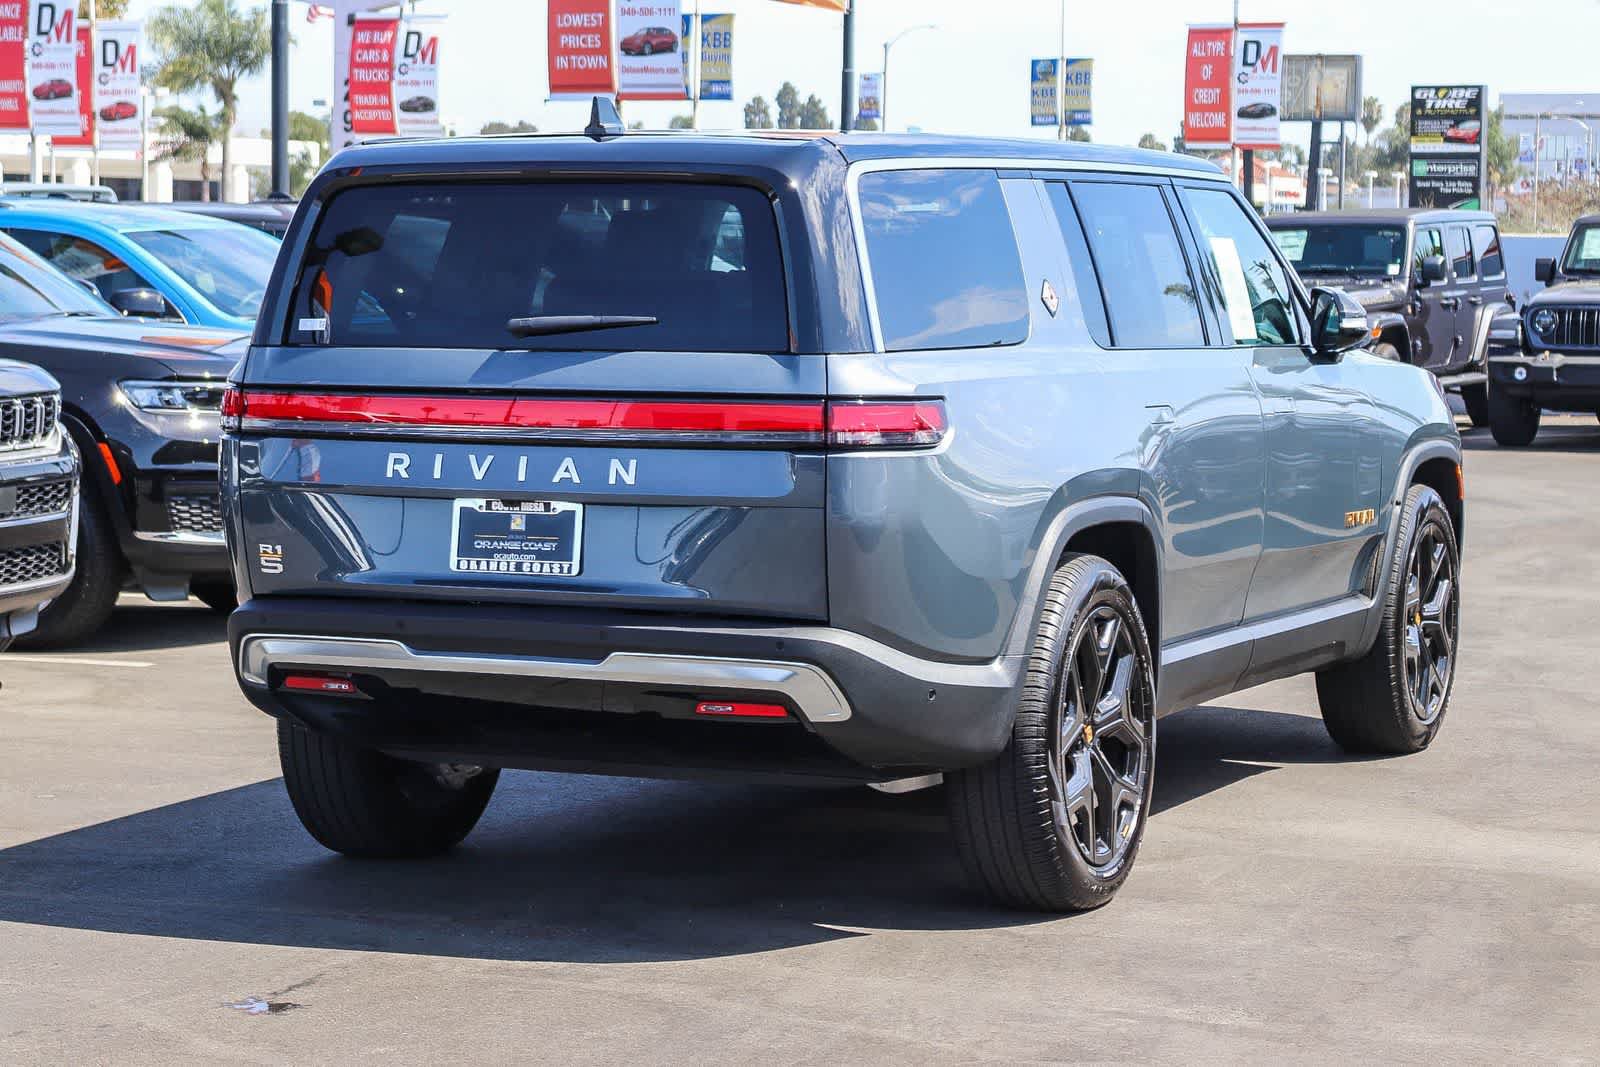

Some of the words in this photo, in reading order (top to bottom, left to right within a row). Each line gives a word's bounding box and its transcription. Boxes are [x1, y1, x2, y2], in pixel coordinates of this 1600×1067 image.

[557, 13, 603, 27] LOWEST
[560, 34, 601, 48] PRICES
[702, 32, 731, 48] KBB
[356, 48, 380, 62] CARS
[1192, 41, 1206, 57] ALL
[1207, 41, 1226, 57] TYPE
[556, 58, 568, 69] IN
[570, 55, 608, 69] TOWN
[354, 68, 390, 81] TRUCKS
[1202, 64, 1213, 80] OF
[1194, 88, 1221, 104] CREDIT
[1424, 99, 1469, 109] TIRE
[1188, 112, 1226, 128] WELCOME
[386, 452, 637, 485] RIVIAN
[474, 540, 520, 550] ORANGE
[521, 541, 558, 551] COAST
[493, 552, 536, 561] ocauto.com
[460, 559, 516, 572] ORANGE
[522, 562, 573, 574] COAST
